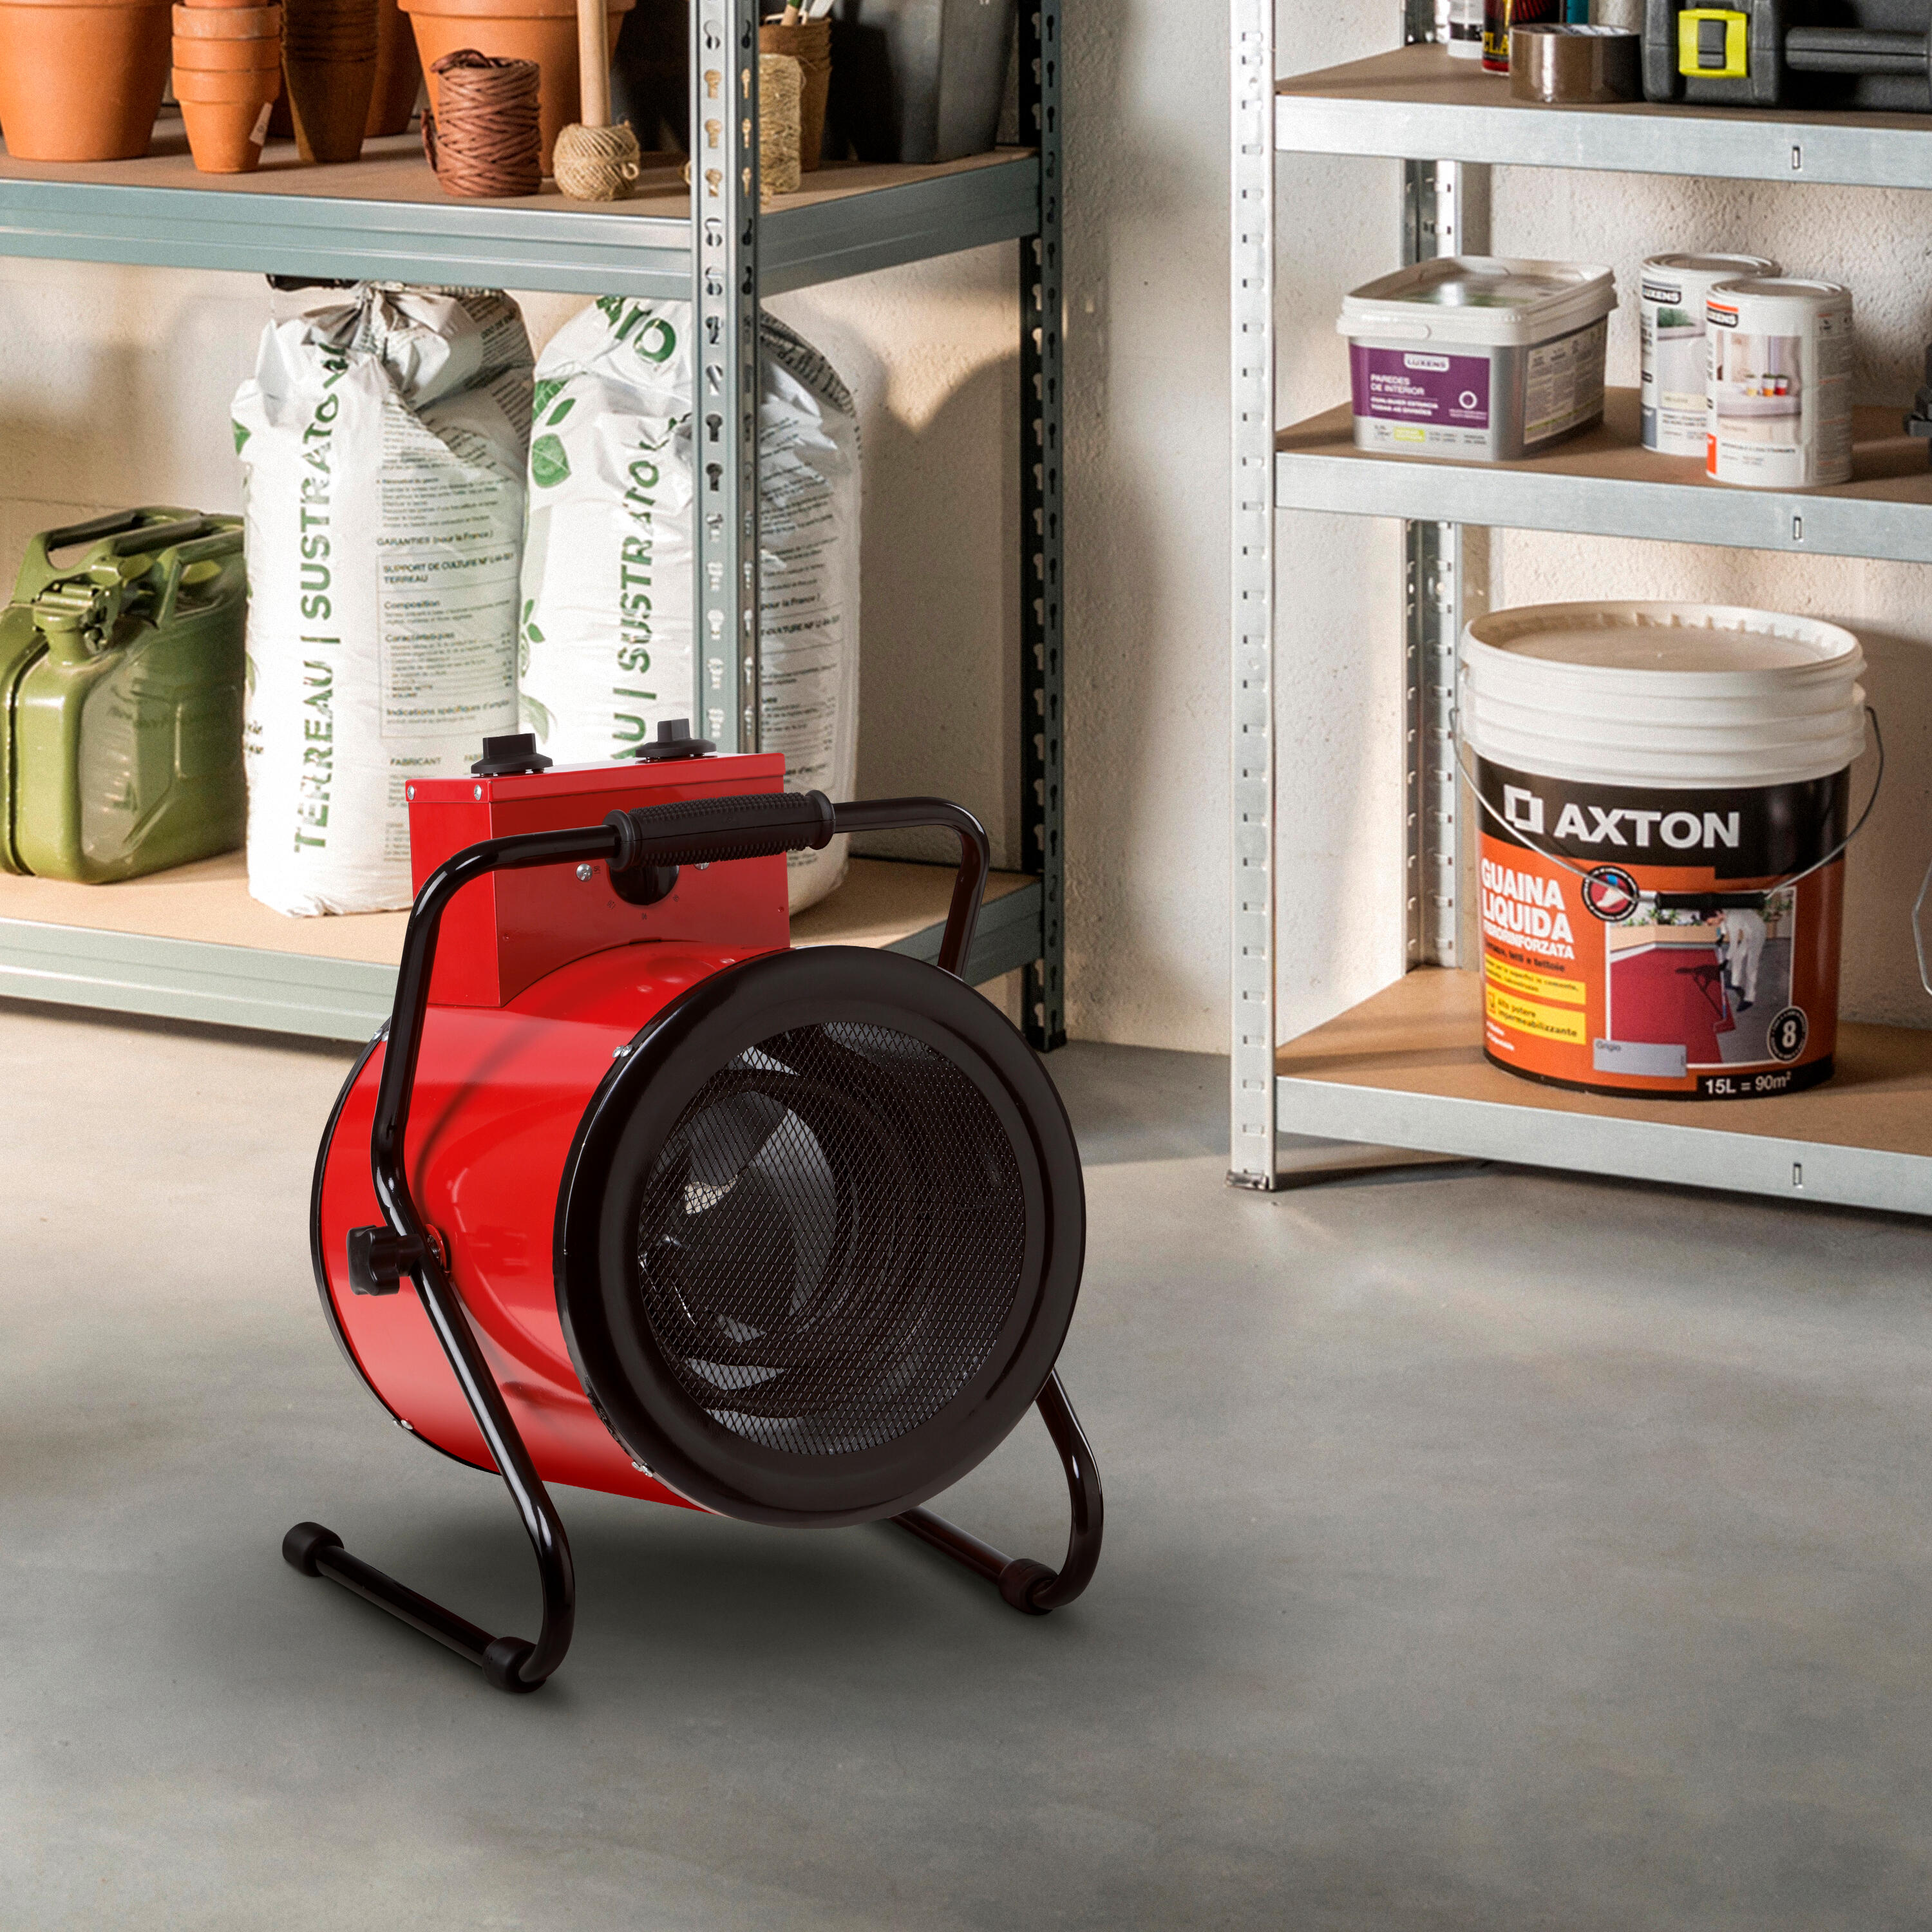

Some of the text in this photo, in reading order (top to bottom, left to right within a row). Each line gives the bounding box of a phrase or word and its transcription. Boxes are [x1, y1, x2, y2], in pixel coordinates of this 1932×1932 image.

[1407, 358, 1446, 368] LUXENS
[1370, 373, 1410, 385] PAREDES
[1370, 383, 1425, 396] DE INTERIOR
[384, 600, 440, 610] Composition
[1553, 802, 1740, 849] AXTON
[1482, 858, 1566, 911] GUAINA
[1482, 888, 1575, 944] LIQUIDA
[1533, 958, 1566, 973] tettoie
[1511, 1004, 1537, 1018] potere
[1498, 1010, 1578, 1038] impermeabilizzante
[1782, 1019, 1797, 1048] 8
[1705, 1079, 1736, 1095] 15L
